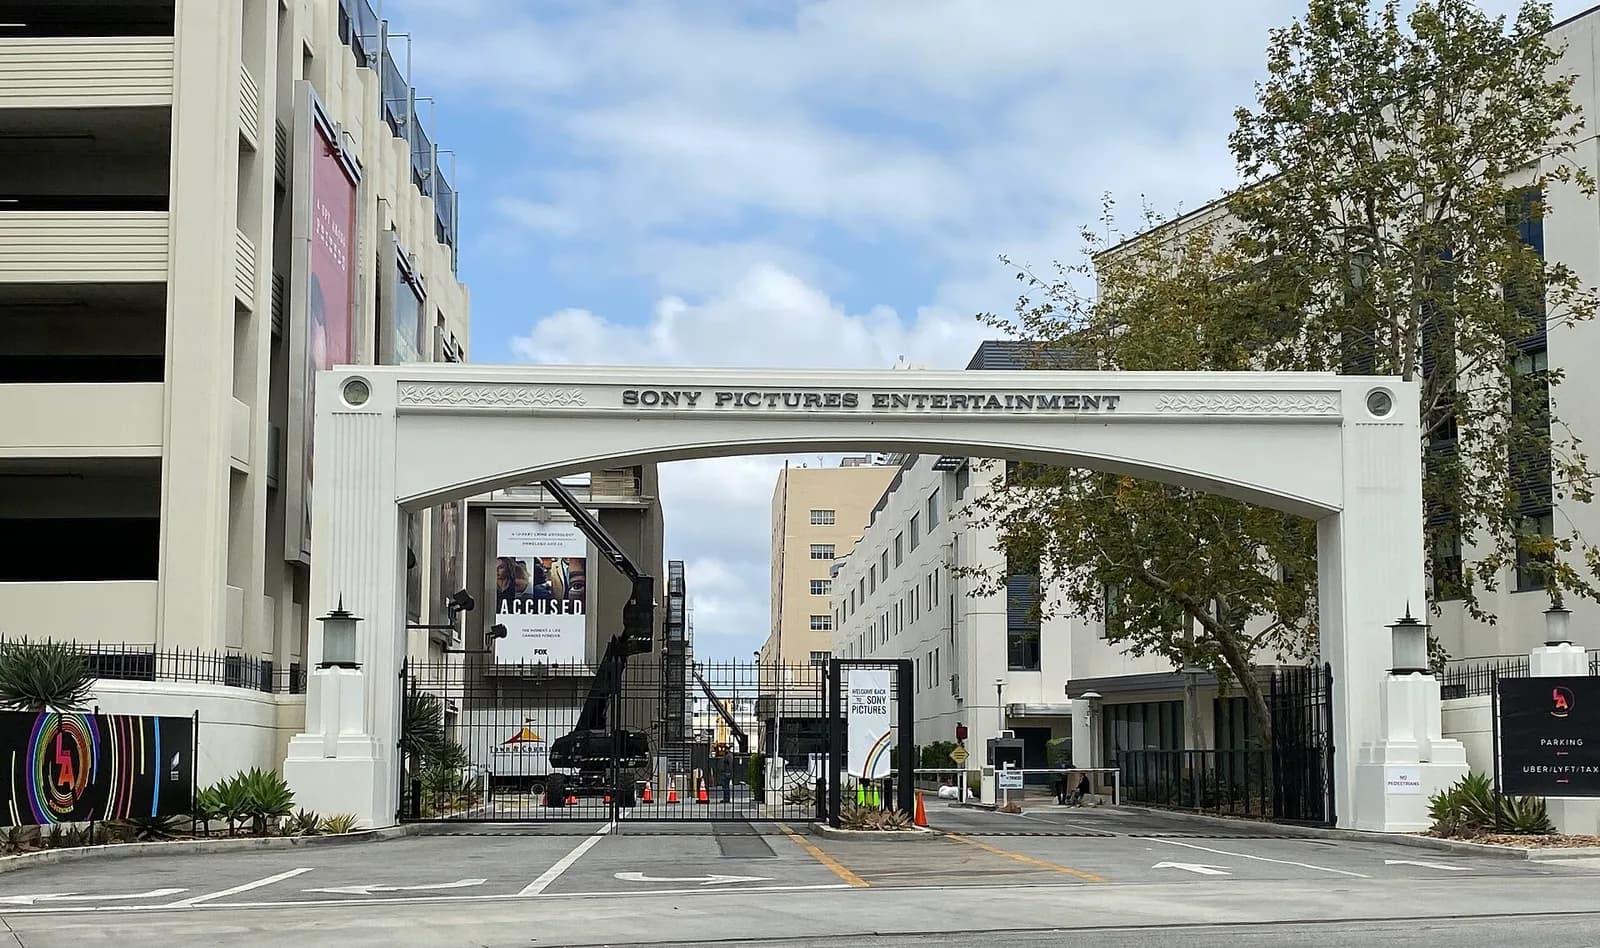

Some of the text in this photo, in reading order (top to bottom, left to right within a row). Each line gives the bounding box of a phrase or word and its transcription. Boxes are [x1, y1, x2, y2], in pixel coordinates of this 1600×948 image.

[622, 389, 1120, 410] SONY PICTURES ENTERTAINMENT
[500, 598, 583, 615] ACCUSED
[534, 648, 548, 656] FOX
[866, 695, 887, 704] SONY
[851, 704, 887, 715] PICTURES
[1540, 738, 1583, 746] PARKING
